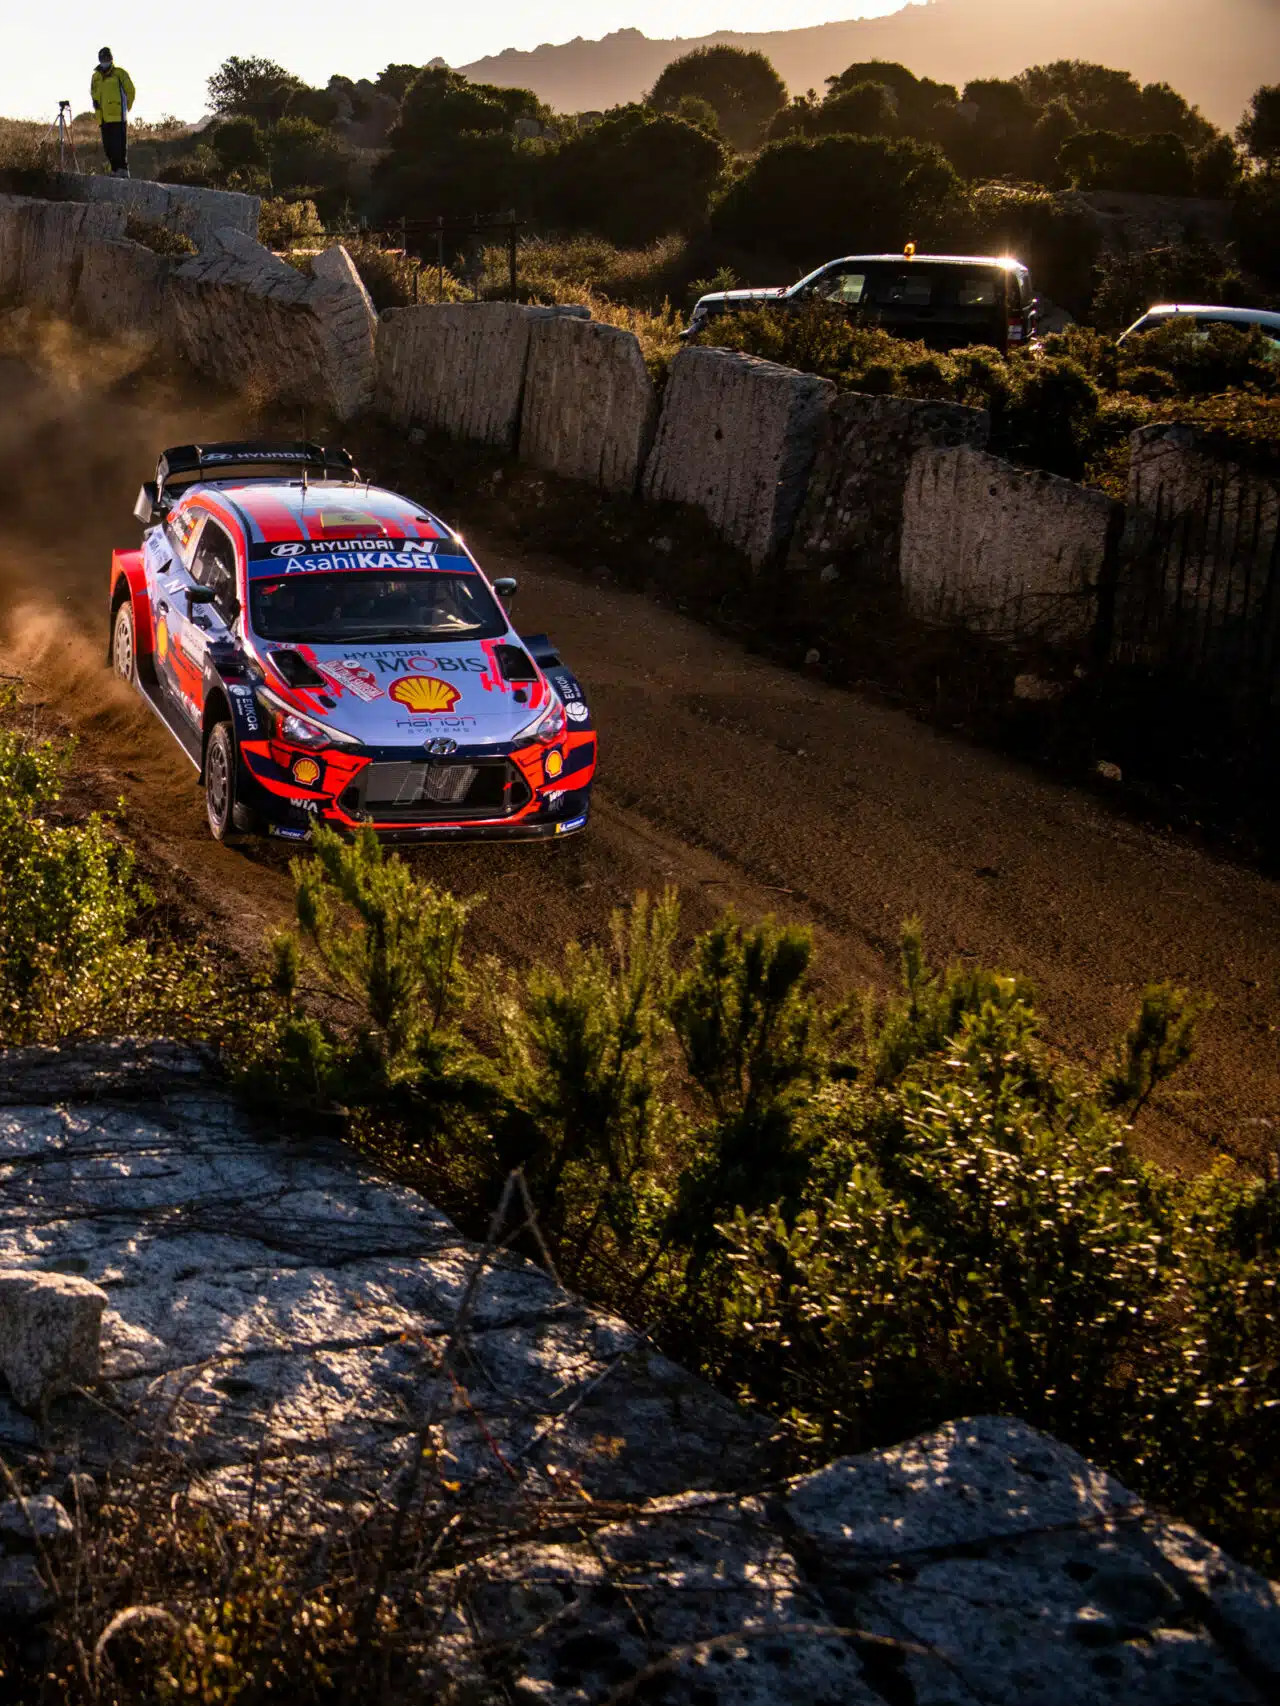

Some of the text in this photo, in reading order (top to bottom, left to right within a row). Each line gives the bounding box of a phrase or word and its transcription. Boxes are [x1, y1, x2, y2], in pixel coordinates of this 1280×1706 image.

[237, 451, 312, 460] HYUNDAI
[311, 540, 395, 552] HYUNDAI
[343, 650, 428, 660] HYUNDAI
[375, 656, 489, 673] MOBIS
[554, 675, 576, 699] EUKOR
[242, 698, 259, 731] EUKOR
